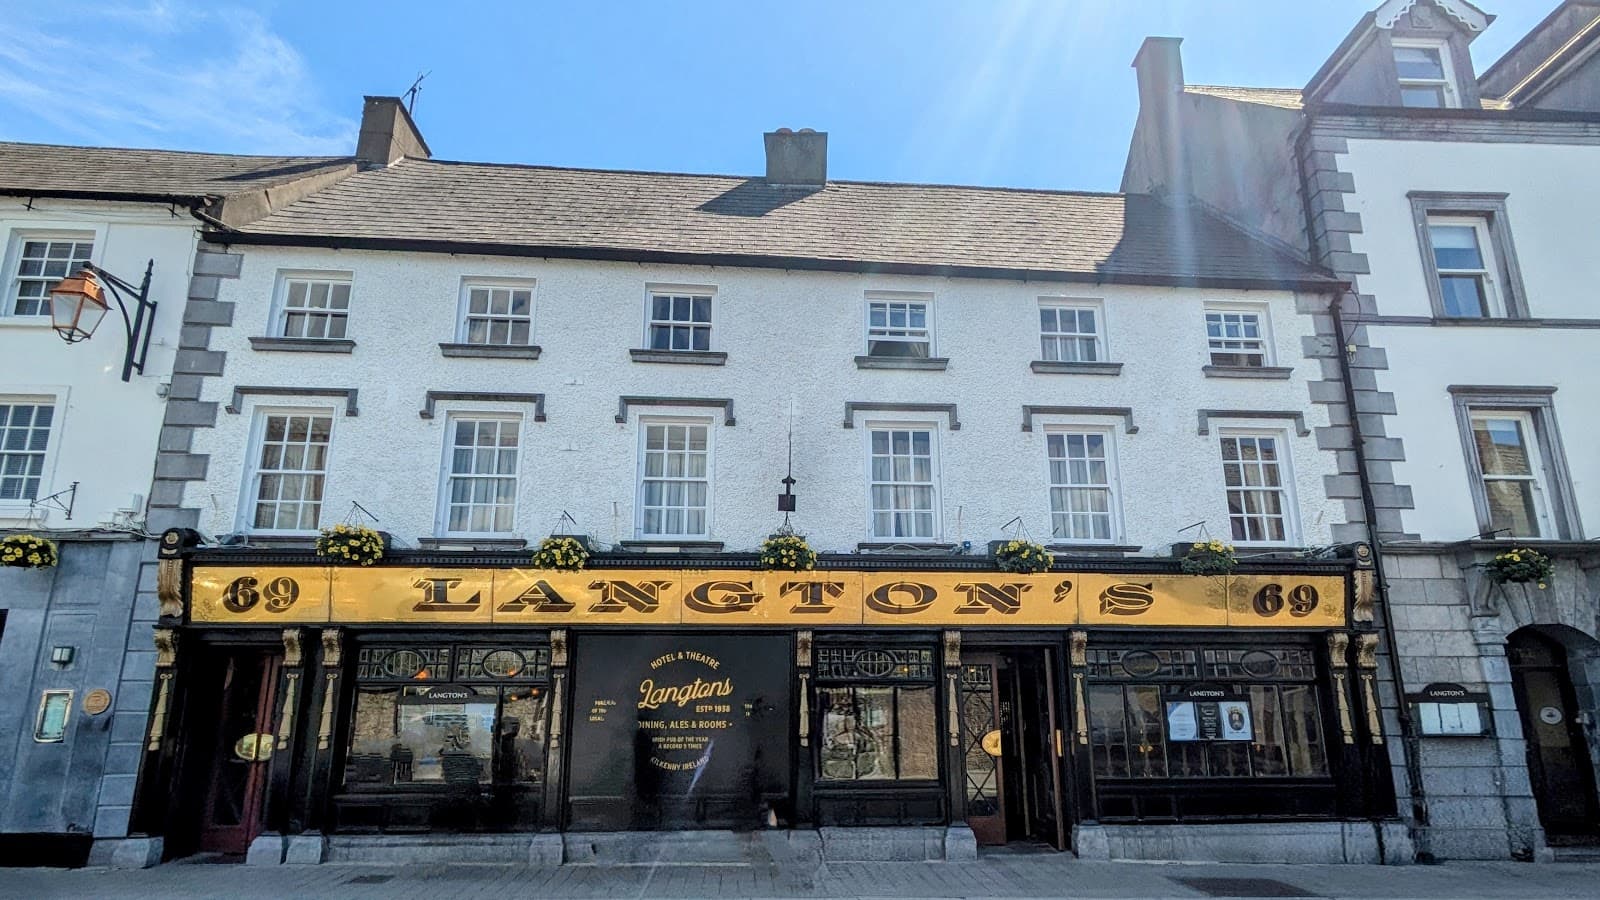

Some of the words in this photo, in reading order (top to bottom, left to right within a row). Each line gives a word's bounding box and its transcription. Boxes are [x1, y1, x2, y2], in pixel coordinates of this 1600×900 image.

[222, 576, 300, 614] 69
[412, 577, 1154, 615] LANGTON'S
[1252, 583, 1320, 617] 69
[650, 653, 676, 670] HOTEL
[677, 651, 683, 660] &
[686, 651, 720, 670] THEATRE
[638, 677, 734, 709] Langtons
[669, 720, 689, 729] ALES
[691, 720, 697, 729] &
[698, 720, 727, 729] ROOMS
